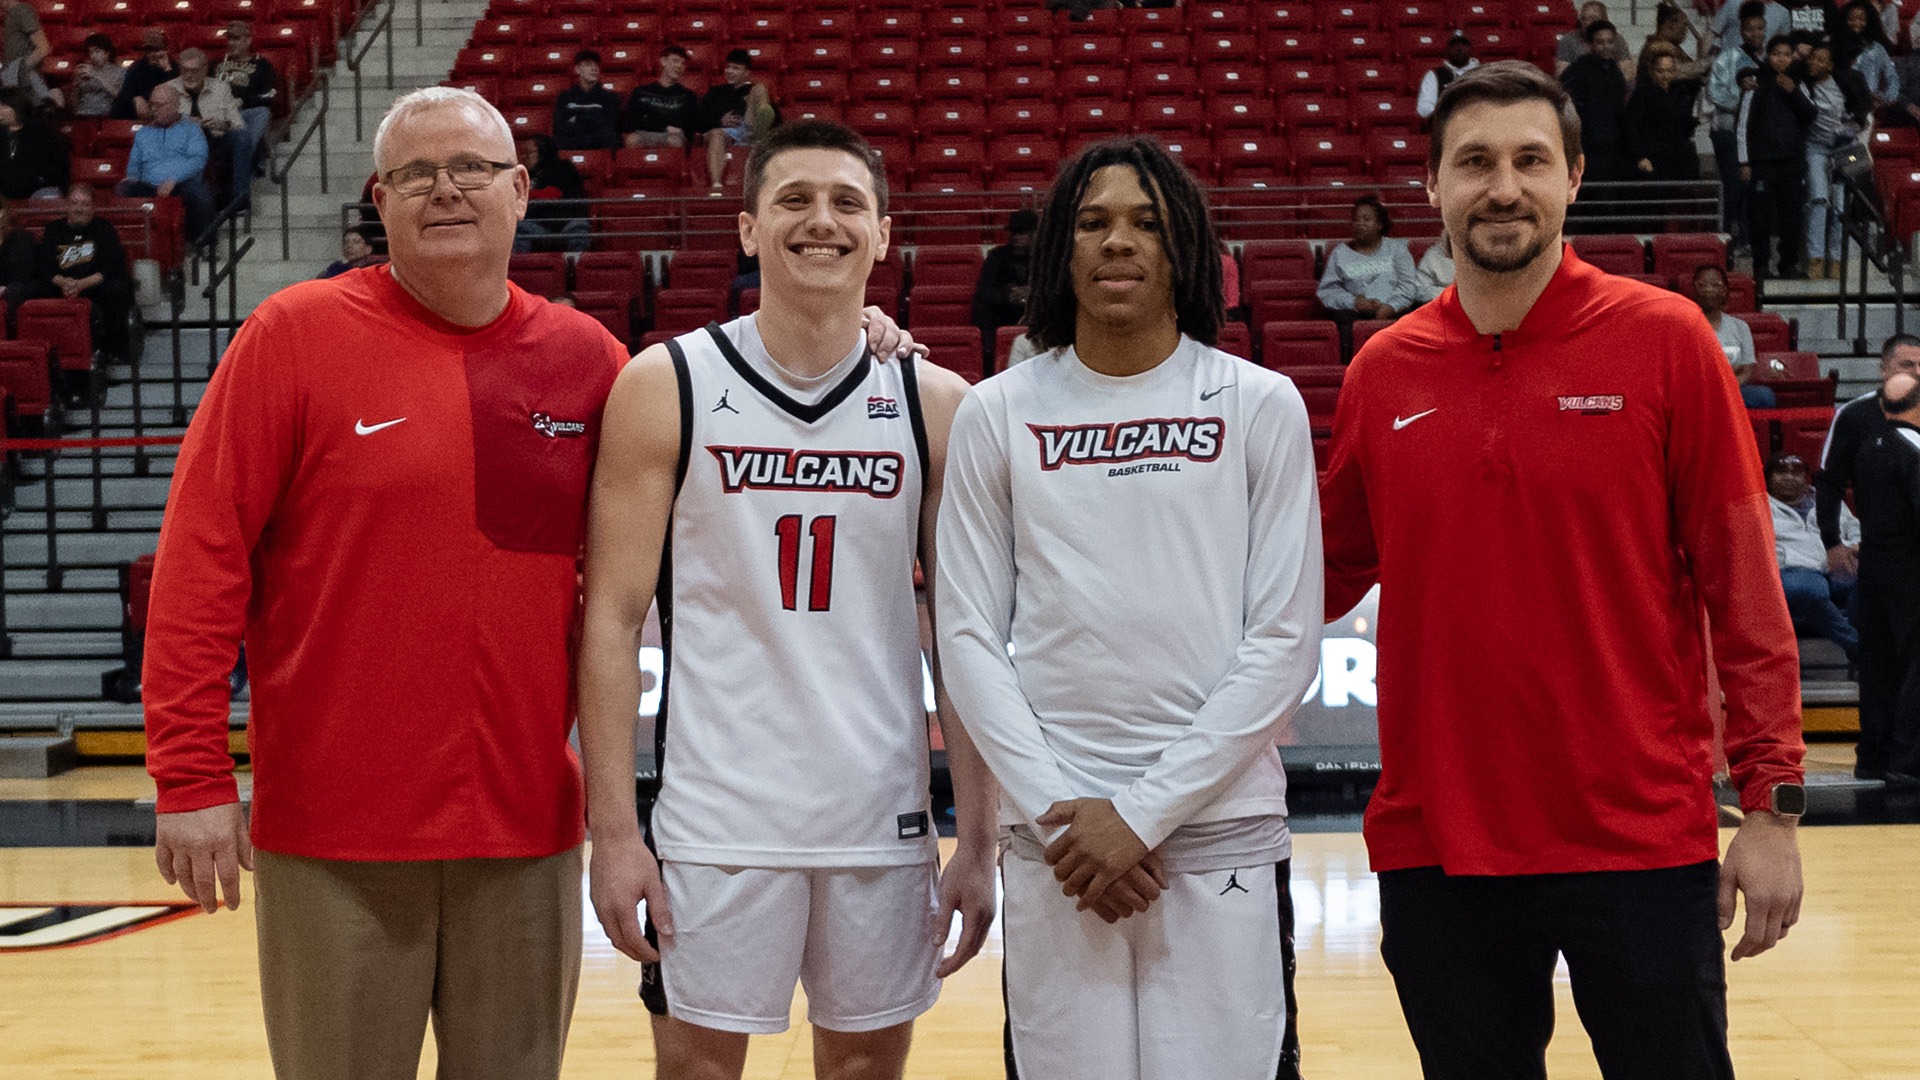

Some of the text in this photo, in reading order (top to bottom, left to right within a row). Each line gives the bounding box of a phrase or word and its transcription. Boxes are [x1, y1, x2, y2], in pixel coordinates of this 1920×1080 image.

[1557, 395, 1623, 411] VULCANS
[551, 421, 586, 433] VULCANS
[1034, 418, 1225, 469] VULCANS
[712, 449, 902, 496] VULCANS
[1107, 462, 1181, 478] BASKETBALL
[774, 514, 837, 612] 11
